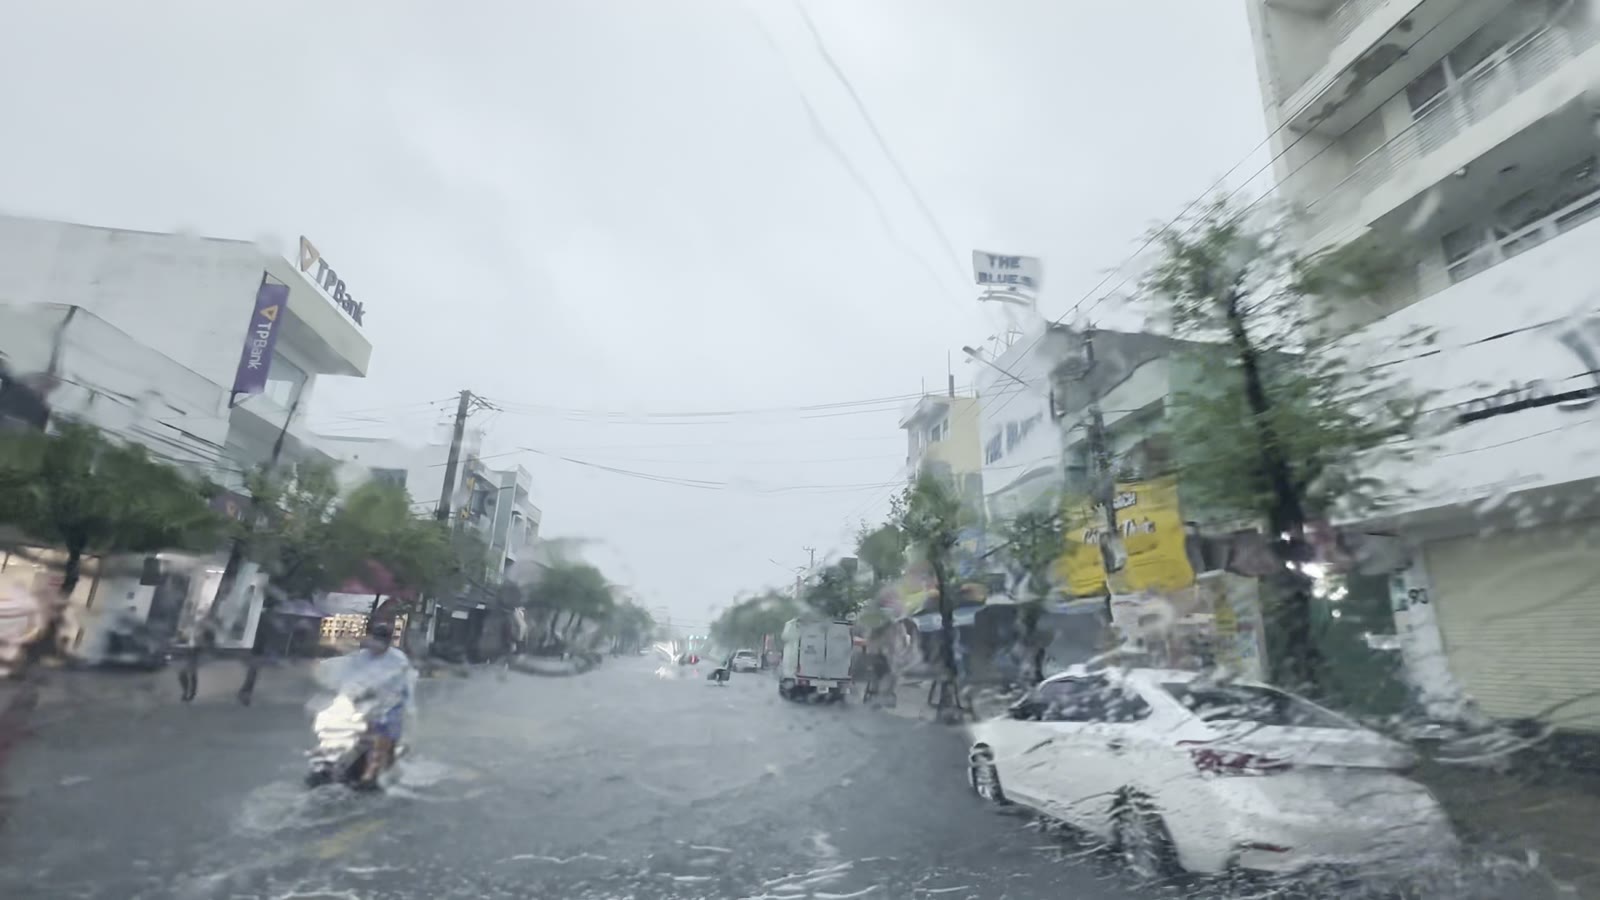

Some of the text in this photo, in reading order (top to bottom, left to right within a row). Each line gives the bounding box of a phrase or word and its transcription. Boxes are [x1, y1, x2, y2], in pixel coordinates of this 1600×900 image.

[986, 254, 1021, 269] THE
[316, 257, 366, 327] TPBank
[247, 322, 273, 370] TPBank
